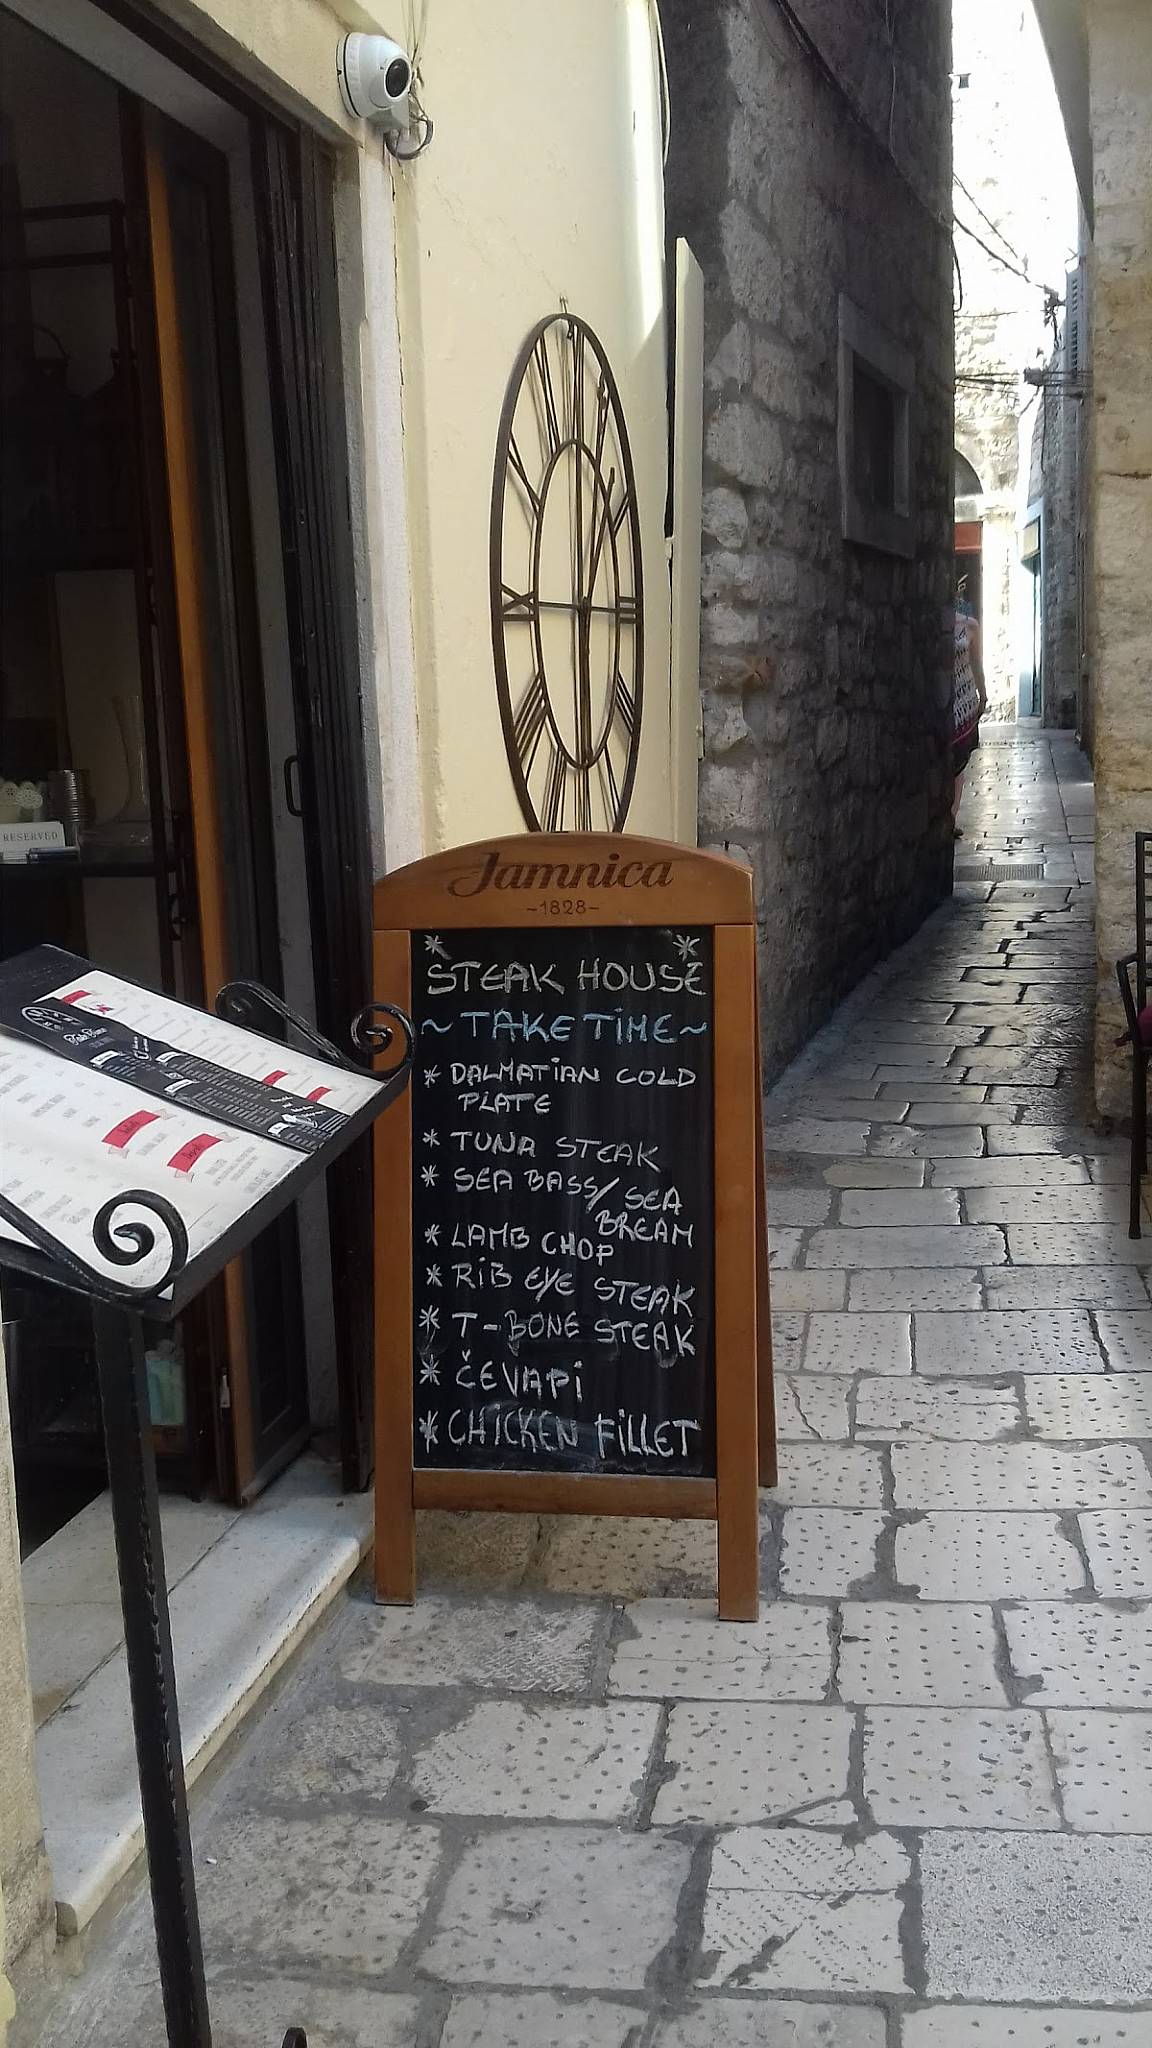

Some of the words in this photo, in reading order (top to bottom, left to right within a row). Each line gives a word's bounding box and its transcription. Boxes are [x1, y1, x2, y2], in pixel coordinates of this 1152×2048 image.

[3, 832, 58, 842] RESERVED
[447, 852, 673, 897] Jamnica
[427, 960, 565, 995] STEAK
[577, 959, 707, 995] HOUSE
[450, 1058, 600, 1085] DALMATIAN
[616, 1067, 696, 1086] COLD
[458, 1092, 552, 1114] PLATE
[449, 1131, 536, 1158] TUNA
[555, 1136, 661, 1173] STEAK
[454, 1167, 514, 1192] SEA
[523, 1169, 619, 1212] BASS/
[624, 1186, 684, 1214] SEA
[451, 1223, 530, 1249] LAMB
[541, 1231, 615, 1265] CHOP
[595, 1210, 694, 1248] BREAM
[451, 1257, 512, 1289] RIB
[524, 1265, 575, 1303] EYE
[594, 1278, 696, 1317] STEAK
[594, 1319, 697, 1358] STEAK
[455, 1352, 584, 1402] ČEVAPI
[448, 1404, 579, 1452] CHICKEN
[594, 1409, 702, 1459] FILLET
